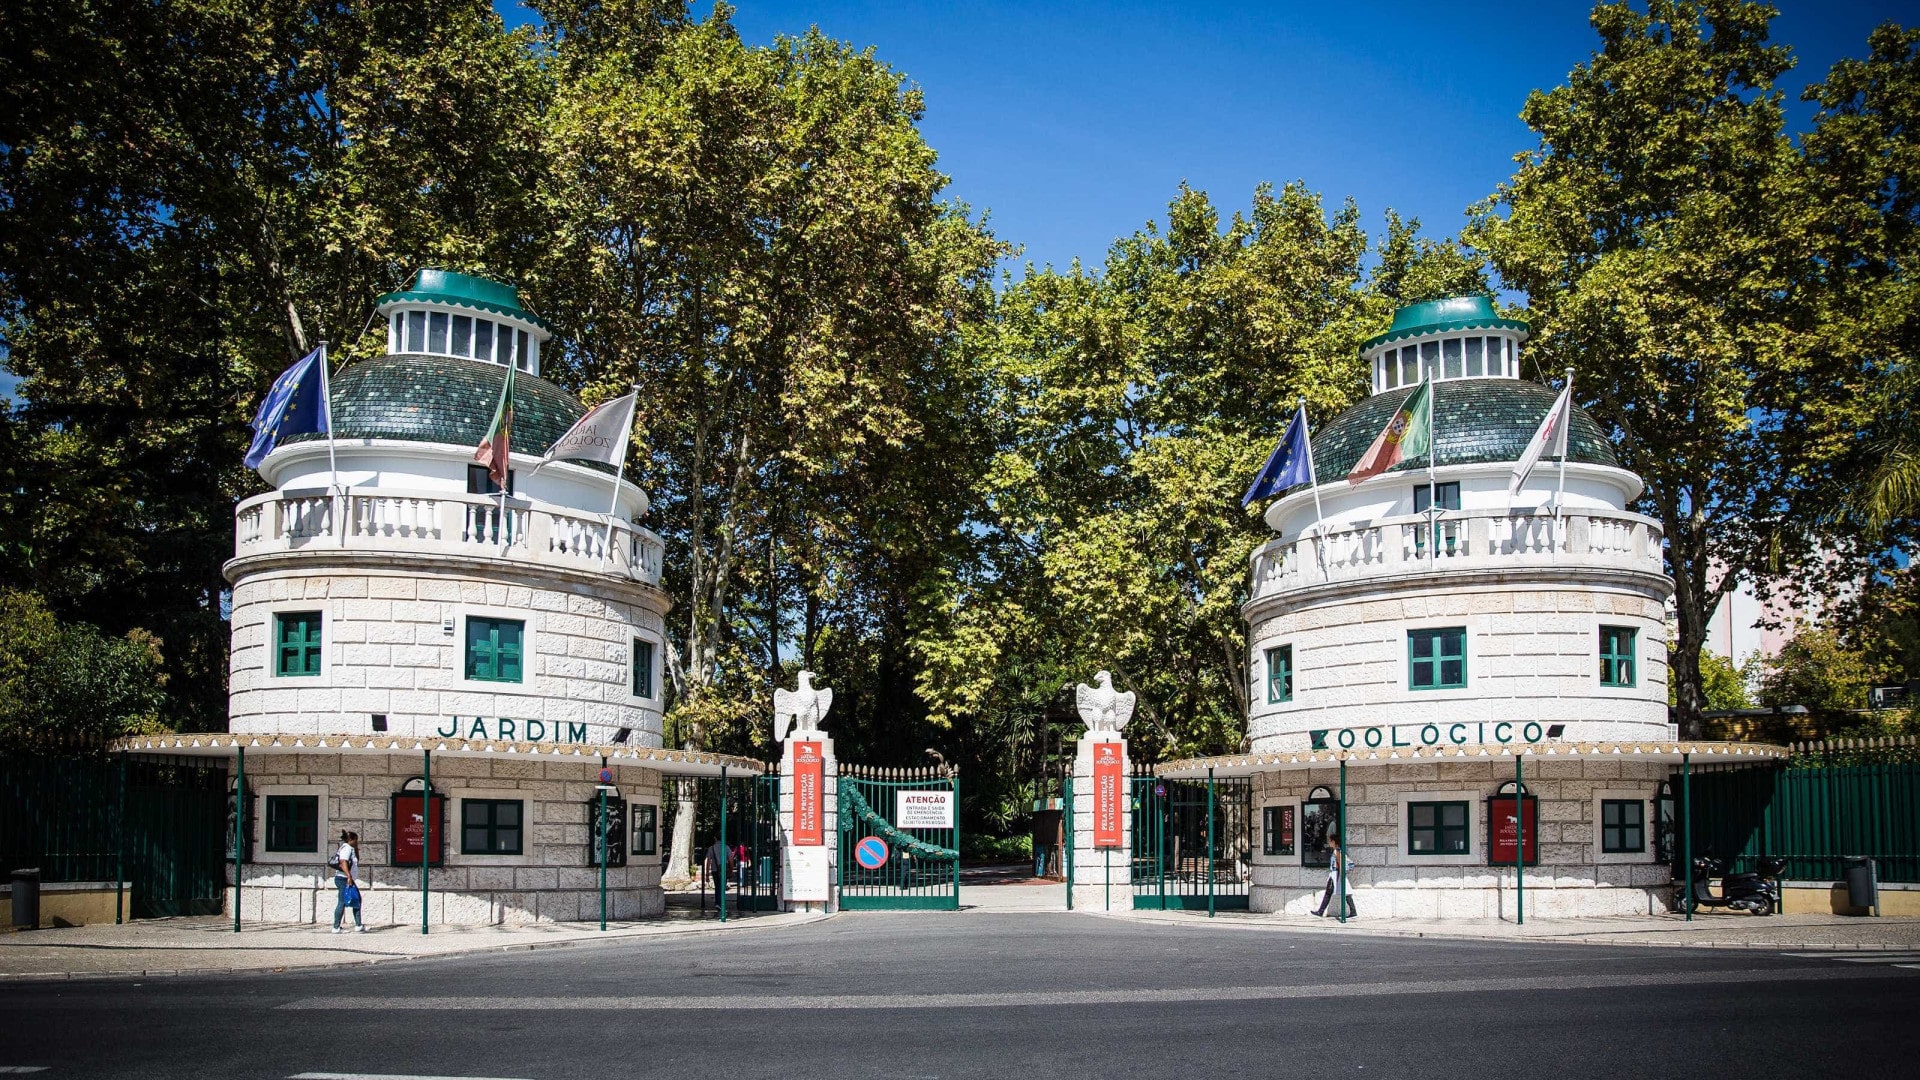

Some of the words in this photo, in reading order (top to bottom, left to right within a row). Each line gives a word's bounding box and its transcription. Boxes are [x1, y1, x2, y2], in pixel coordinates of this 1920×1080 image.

[437, 715, 587, 744] JARDIM
[906, 794, 946, 805] ATENÇÃO
[808, 820, 814, 830] DA
[1108, 821, 1114, 831] DA
